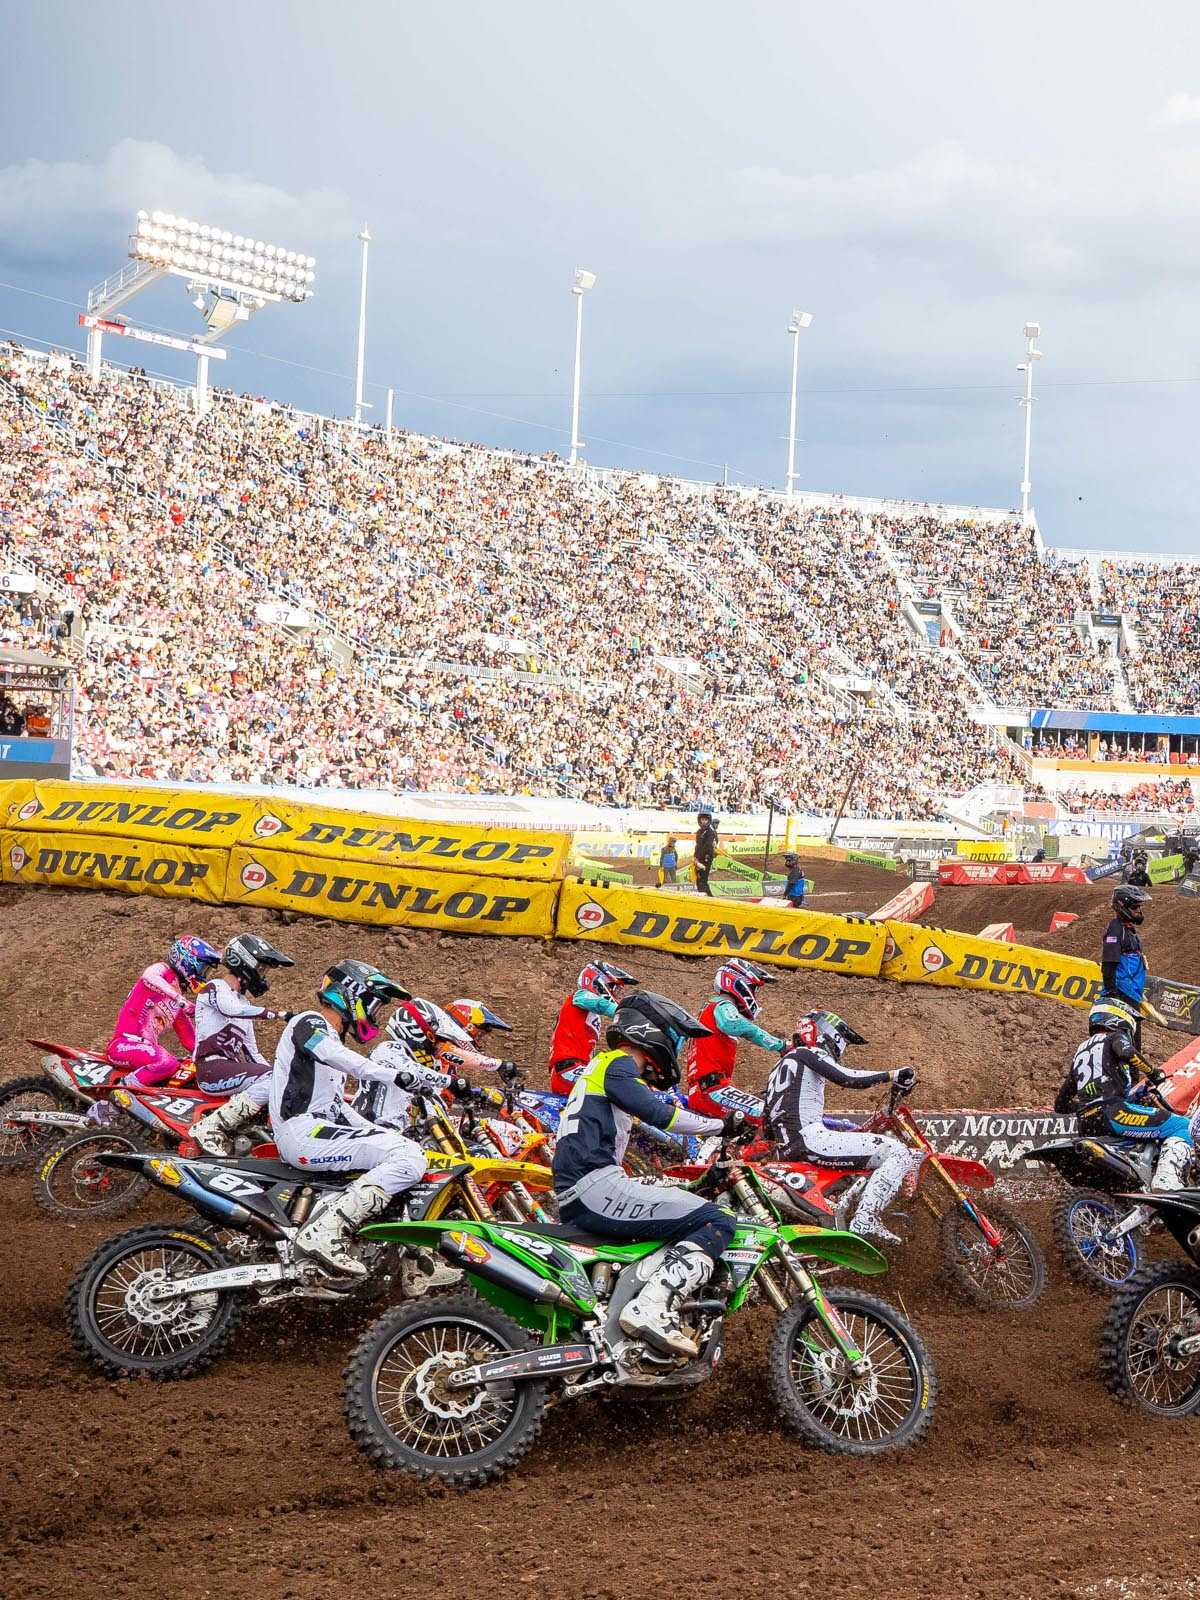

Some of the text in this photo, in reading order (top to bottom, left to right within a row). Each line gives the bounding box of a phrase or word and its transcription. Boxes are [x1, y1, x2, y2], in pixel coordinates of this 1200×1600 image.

[275, 610, 290, 622] 37
[44, 799, 242, 834] DUNLOP
[993, 824, 1037, 835] MNSTER
[294, 821, 555, 864] DUNLOP
[850, 855, 888, 869] Kawasaki
[969, 852, 1013, 861] DUNLOP
[36, 847, 209, 888] DUNLOP
[726, 861, 760, 880] Kawasaki
[280, 868, 532, 922] DUNLOP
[619, 910, 870, 965] DUNLOP
[341, 975, 367, 997] FLY
[1162, 990, 1183, 1001] SUPER
[1162, 998, 1180, 1008] MOTO
[1160, 1004, 1178, 1015] CROSS
[440, 1051, 465, 1065] KTM
[1129, 1053, 1152, 1076] THOR
[72, 1061, 113, 1086] 34
[1073, 1042, 1105, 1091] 31
[1113, 1109, 1150, 1127] THOR
[309, 1154, 353, 1165] SUZUKI
[817, 1158, 854, 1168] HONDA
[208, 1172, 265, 1198] 87
[172, 1232, 213, 1251] DUNLOP
[568, 1243, 595, 1256] MOTUL
[726, 1251, 760, 1261] TWISTED
[564, 1350, 582, 1360] RK
